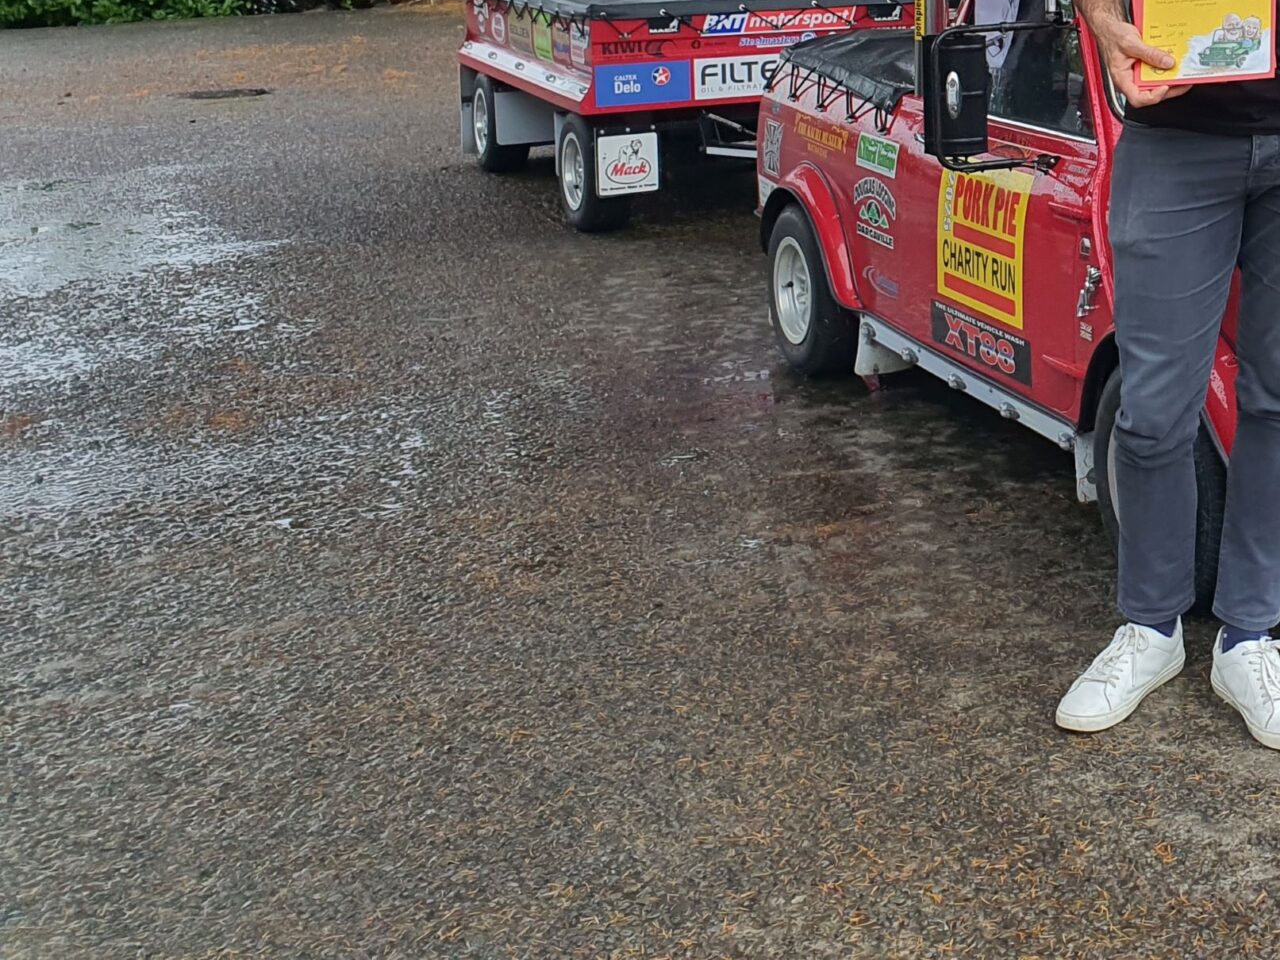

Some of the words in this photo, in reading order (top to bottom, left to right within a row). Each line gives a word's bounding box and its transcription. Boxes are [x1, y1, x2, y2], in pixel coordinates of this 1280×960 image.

[750, 9, 849, 28] motorsport
[602, 41, 642, 55] KIWI
[614, 80, 641, 94] Delo
[953, 174, 995, 228] PORK
[993, 187, 1021, 237] PIE
[943, 239, 989, 283] CHARITY
[992, 257, 1015, 295] RUN
[935, 301, 946, 311] THE
[947, 307, 976, 325] ULTIMATE
[977, 319, 1003, 337] VEHICLE
[1004, 332, 1024, 346] WASH
[944, 312, 1015, 374] XT88
